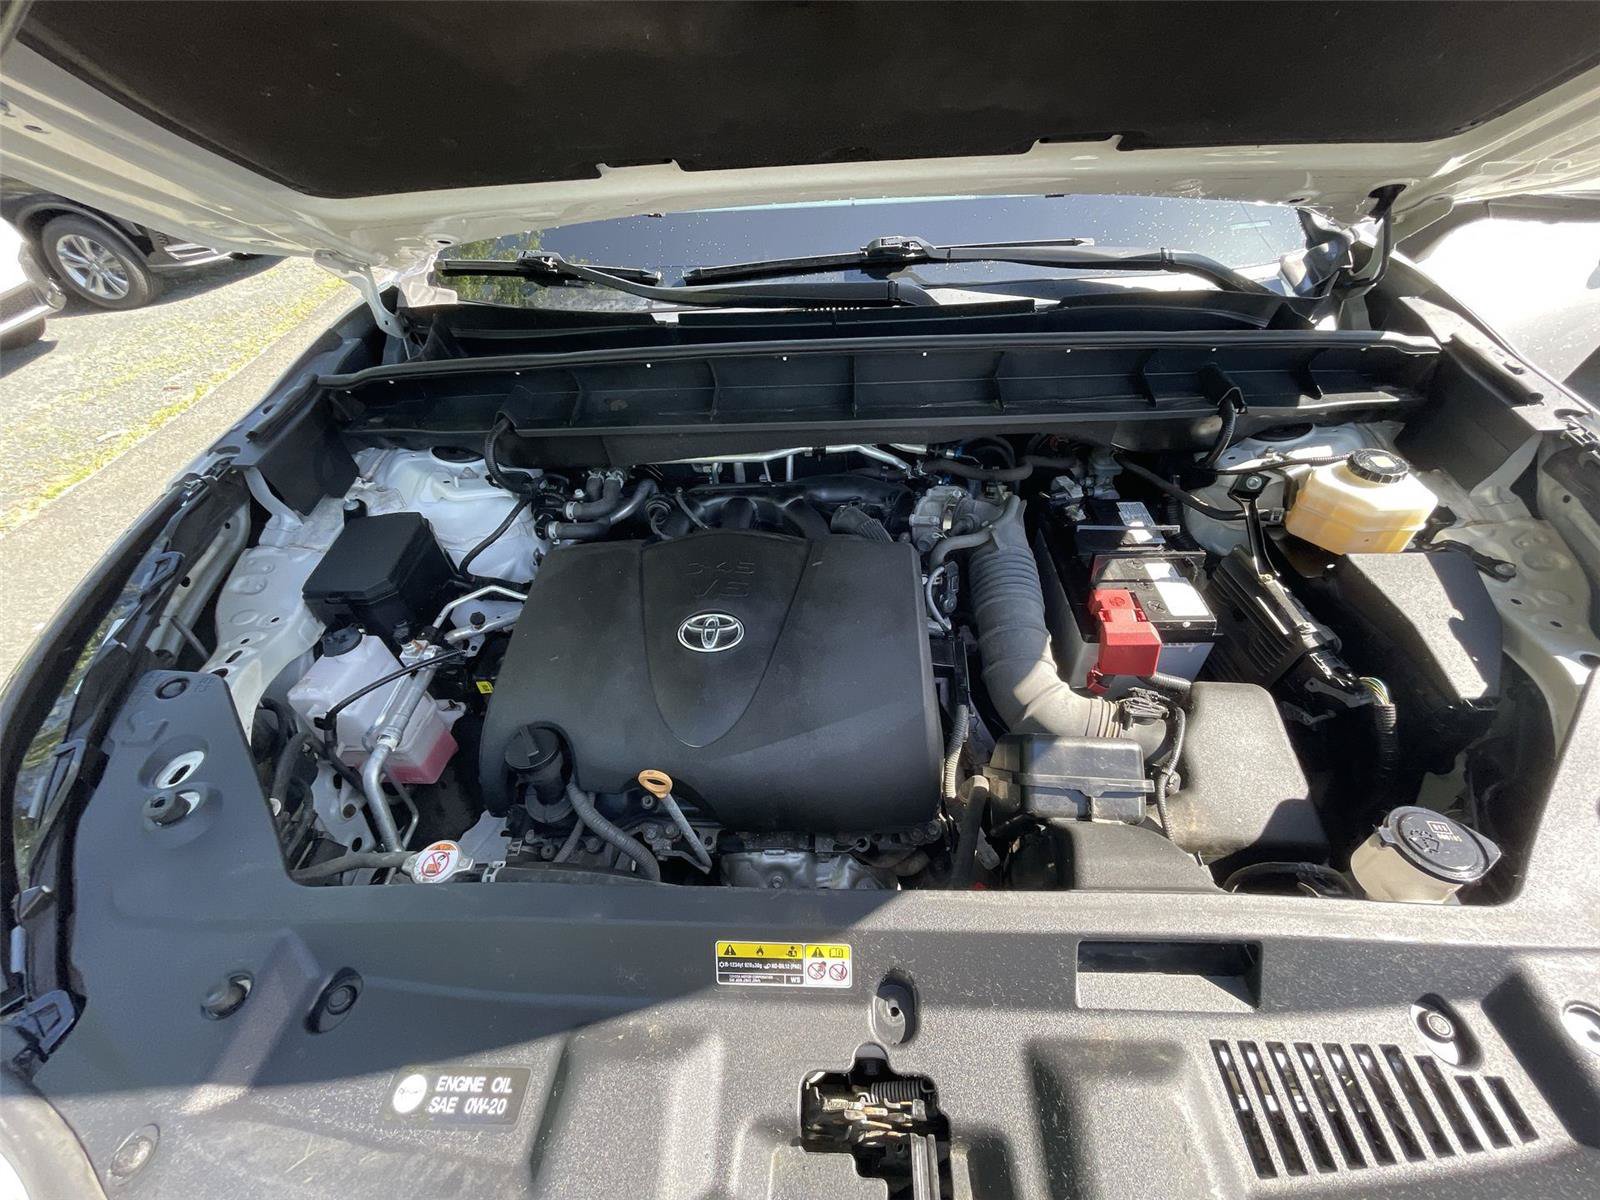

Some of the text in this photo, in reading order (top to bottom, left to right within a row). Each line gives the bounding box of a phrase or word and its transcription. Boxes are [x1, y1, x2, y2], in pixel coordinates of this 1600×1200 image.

[435, 1075, 513, 1094] ENGINE OIL
[428, 1096, 507, 1115] SAE 0W-20
